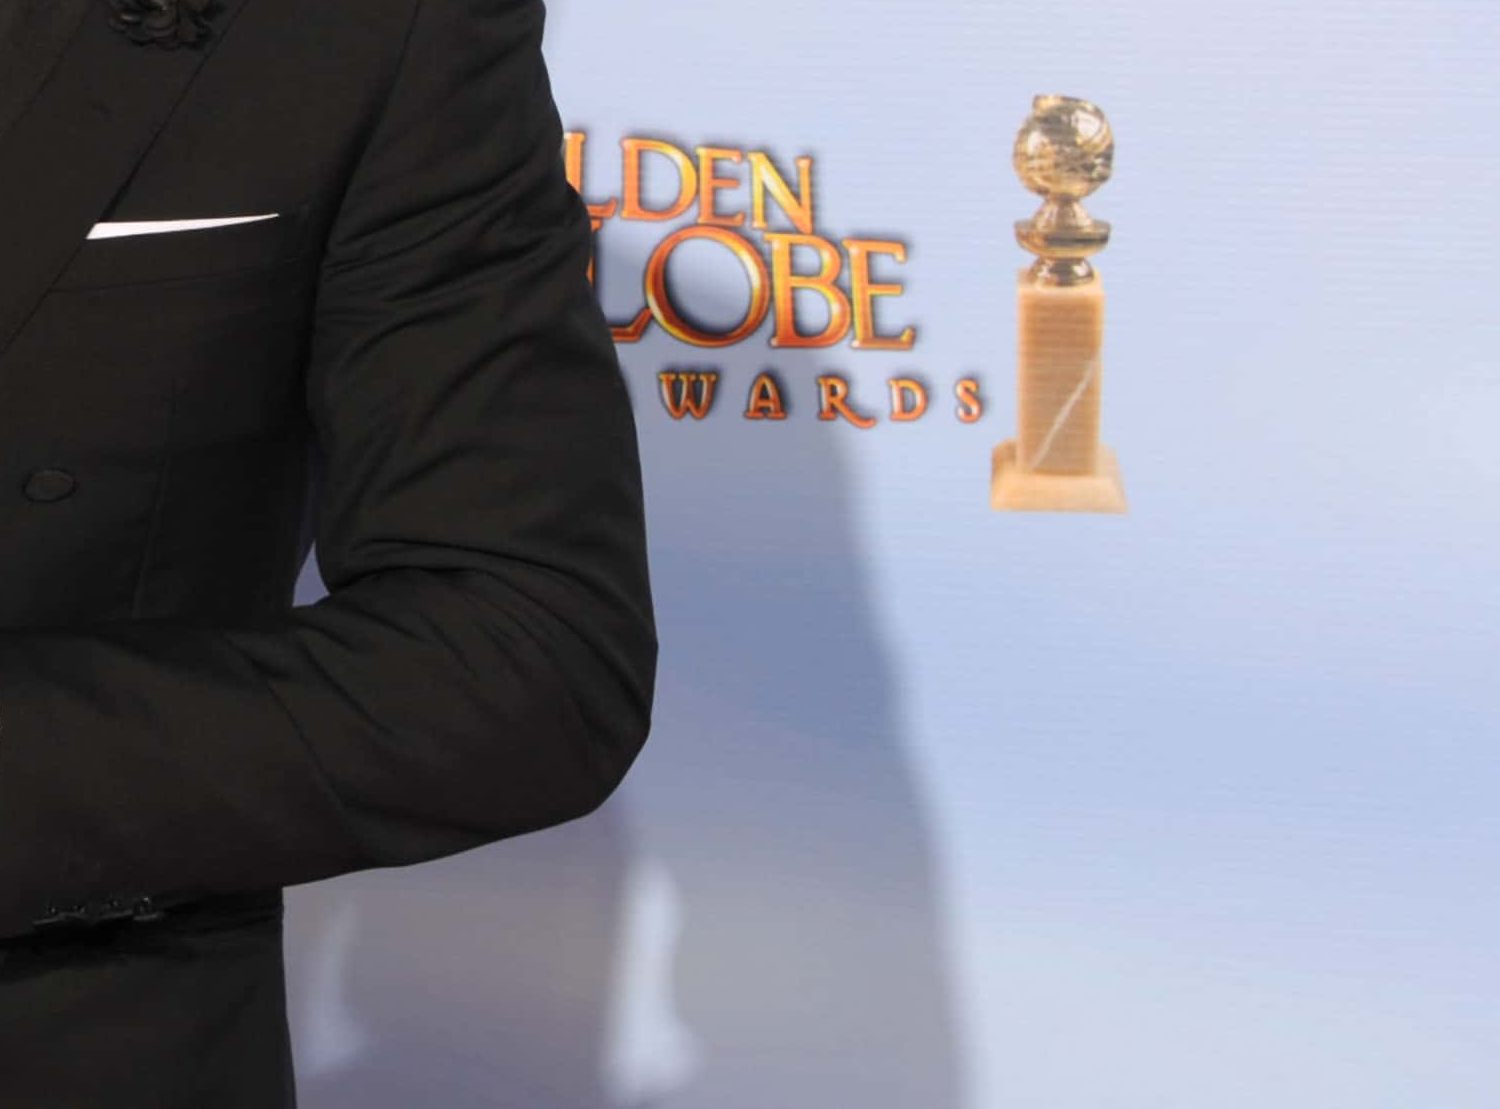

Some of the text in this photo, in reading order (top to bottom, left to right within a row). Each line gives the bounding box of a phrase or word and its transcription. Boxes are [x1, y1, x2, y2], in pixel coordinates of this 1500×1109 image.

[563, 132, 814, 234] LDEN
[587, 220, 916, 350] OBE
[658, 373, 984, 430] WARDS
